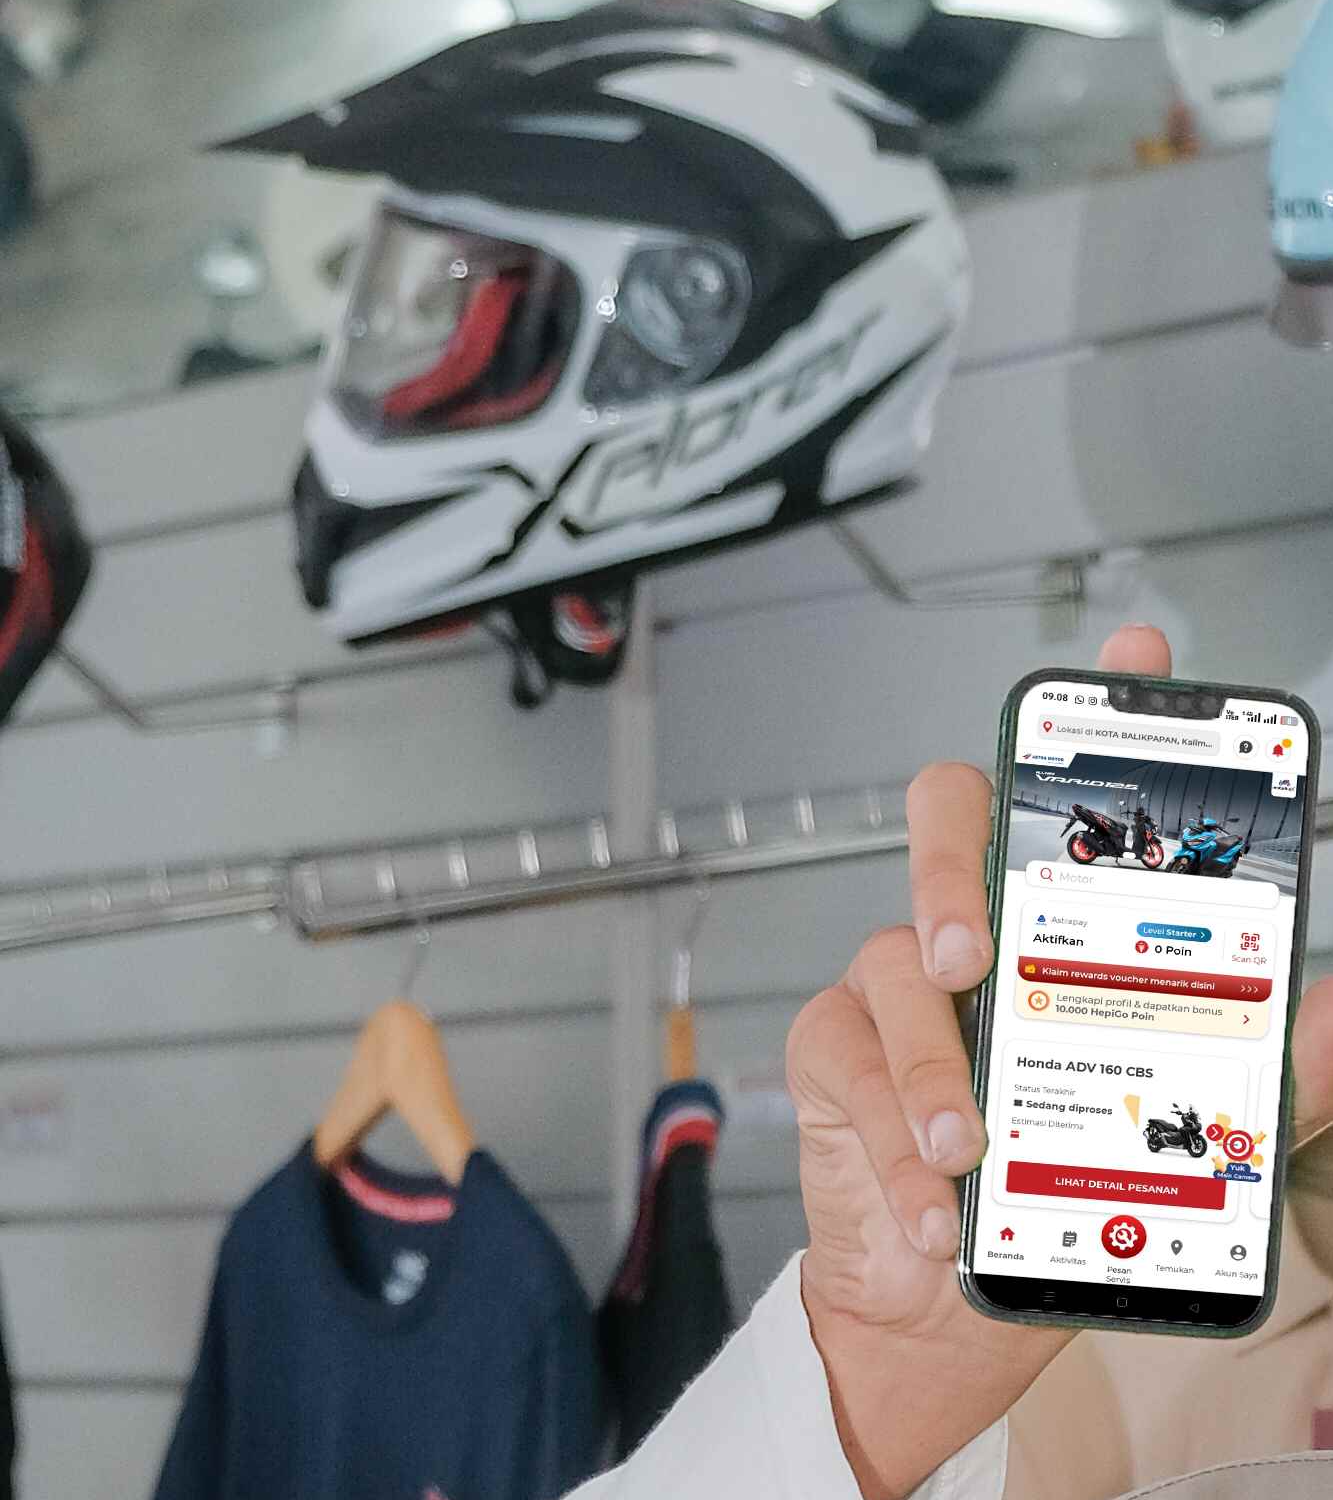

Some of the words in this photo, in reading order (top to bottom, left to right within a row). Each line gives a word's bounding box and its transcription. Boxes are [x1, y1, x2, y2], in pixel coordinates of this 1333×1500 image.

[1042, 692, 1068, 702] 09.08
[1057, 726, 1083, 736] Lokasi
[1085, 728, 1094, 737] di
[1095, 729, 1119, 739] KOTA
[1060, 872, 1095, 884] Motor
[1143, 926, 1165, 935] Level
[1166, 928, 1197, 938] Starter
[1033, 933, 1084, 947] Aktifkan
[1166, 945, 1192, 957] Poin
[1231, 954, 1250, 963] Scan
[1253, 956, 1267, 966] QR
[1042, 967, 1069, 978] Klaim
[1071, 970, 1109, 981] rewards
[1110, 973, 1149, 985] voucher
[1150, 976, 1189, 988] menarik
[1190, 980, 1215, 990] disini
[1056, 993, 1103, 1008] Lengkapi
[1105, 997, 1132, 1011] profil
[1134, 1000, 1142, 1008] &
[1143, 1001, 1190, 1015] dapatkan
[1192, 1005, 1223, 1016] bonus
[1056, 1004, 1088, 1015] 10.000
[1090, 1007, 1129, 1020] HepiGo
[1131, 1011, 1155, 1021] Poin
[1017, 1056, 1062, 1071] Honda
[1066, 1060, 1097, 1074] ADV
[1100, 1063, 1122, 1076] 160
[1126, 1066, 1154, 1079] CBS
[1014, 1084, 1041, 1094] Status
[1043, 1086, 1077, 1097] Terakhir
[1026, 1100, 1066, 1113] Sedang
[1068, 1103, 1113, 1116] diproses
[1011, 1116, 1046, 1127] Estimasi
[1048, 1119, 1085, 1131] Diterima
[1229, 1164, 1246, 1172] Yuk
[1055, 1177, 1086, 1188] LIHAT
[1088, 1180, 1126, 1191] DETAIL
[1127, 1183, 1179, 1196] PESANAN
[987, 1251, 1025, 1261] Beranda
[1049, 1255, 1087, 1266] Aktivitas
[1107, 1266, 1132, 1274] Pesan
[1154, 1264, 1194, 1274] Temukan
[1214, 1269, 1238, 1278] Akun
[1239, 1271, 1258, 1281] Saya
[1105, 1275, 1131, 1284] Servis
